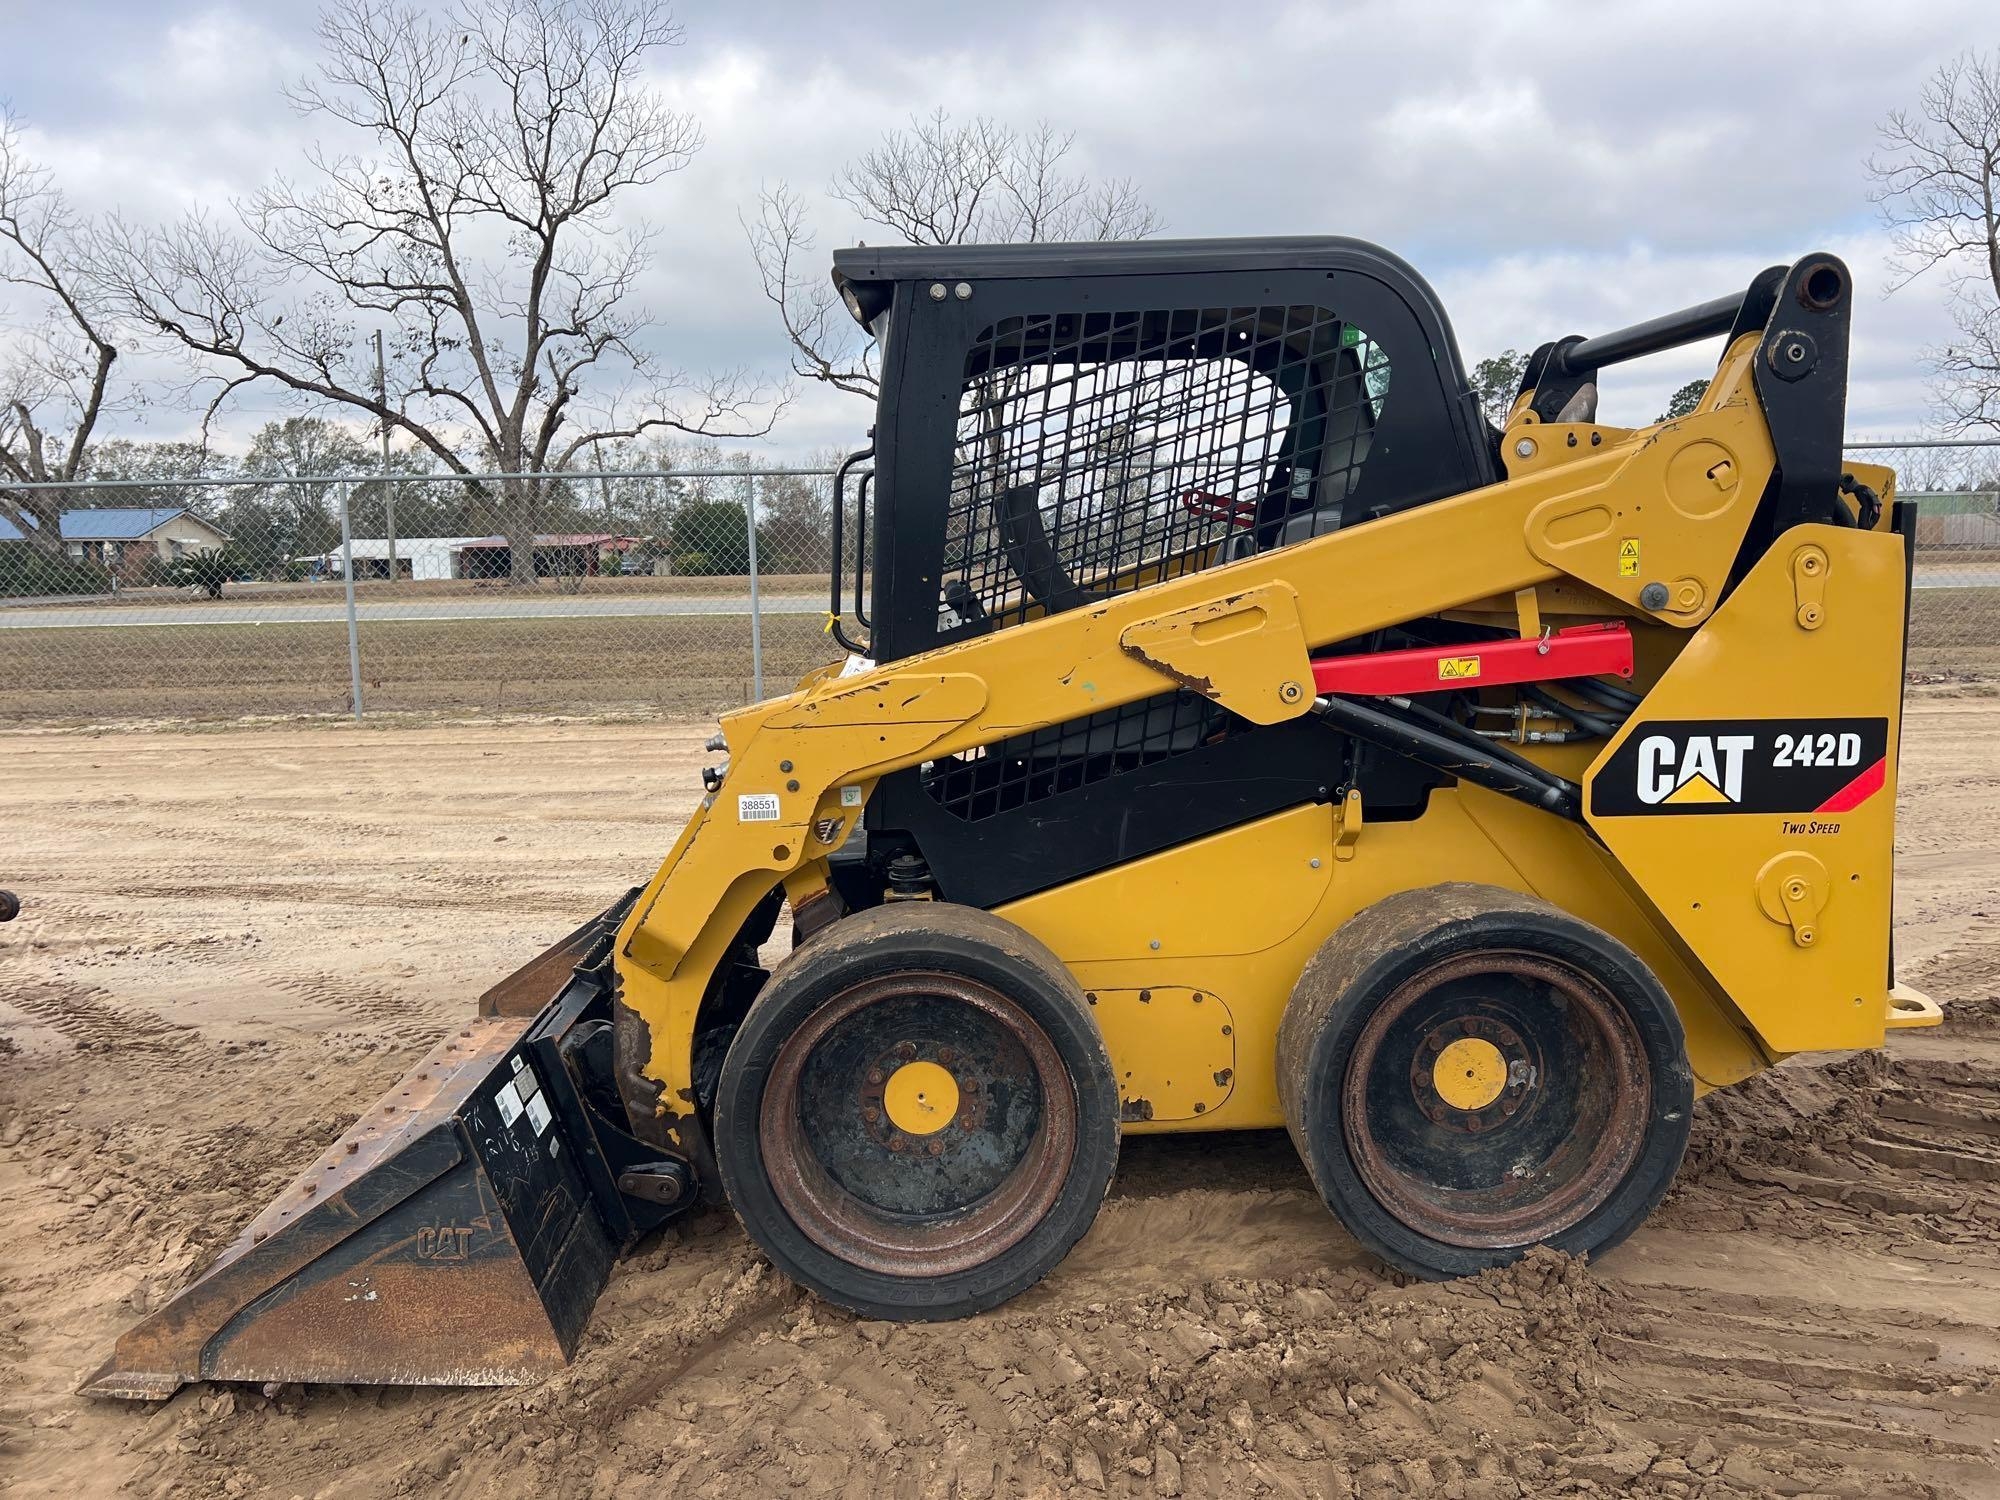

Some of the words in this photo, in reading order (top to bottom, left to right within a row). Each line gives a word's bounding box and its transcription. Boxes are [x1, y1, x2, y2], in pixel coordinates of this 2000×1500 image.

[1637, 735, 1754, 804] CAT
[1773, 733, 1861, 767] 242D
[741, 800, 776, 811] 388551
[417, 1226, 474, 1260] CAT
